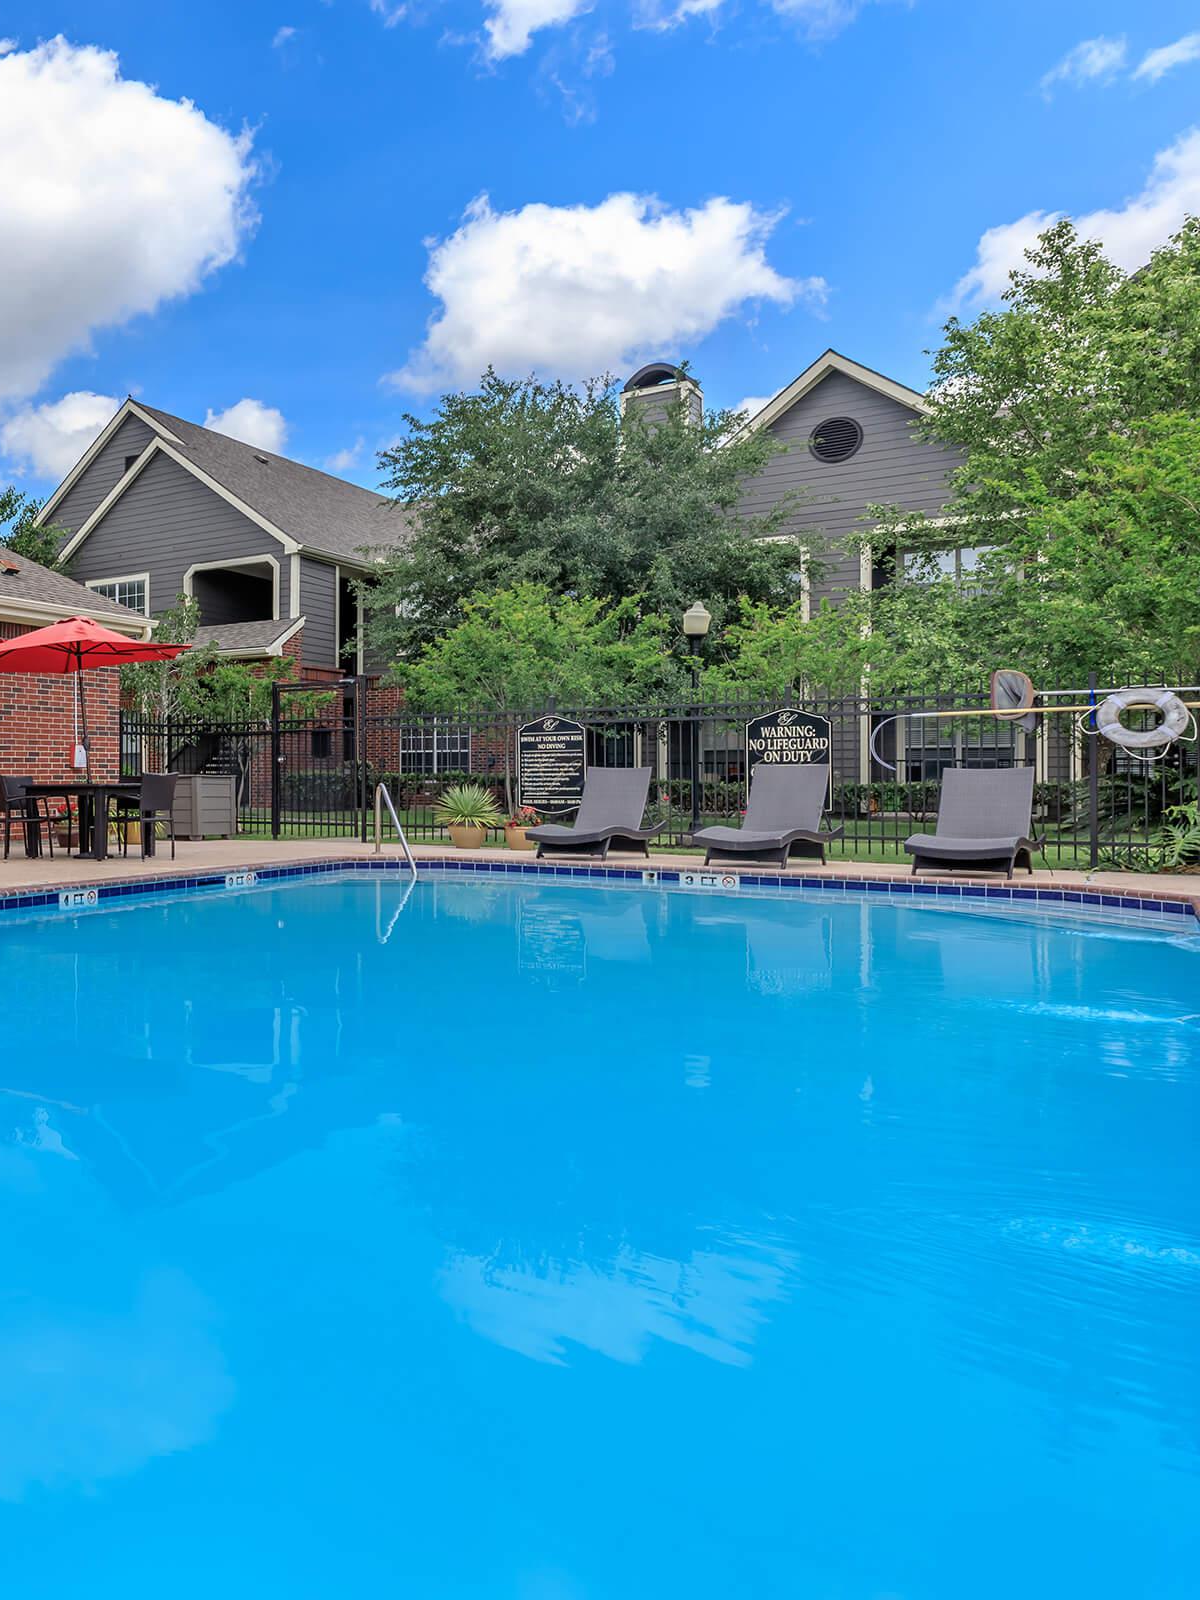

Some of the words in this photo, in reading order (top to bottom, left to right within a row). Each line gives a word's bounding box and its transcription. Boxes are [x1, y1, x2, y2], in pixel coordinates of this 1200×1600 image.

[760, 726, 816, 737] WARNING:
[749, 739, 765, 751] NO
[767, 738, 828, 750] LIFEGUARD
[764, 751, 780, 762] ON
[783, 750, 812, 762] DUTY
